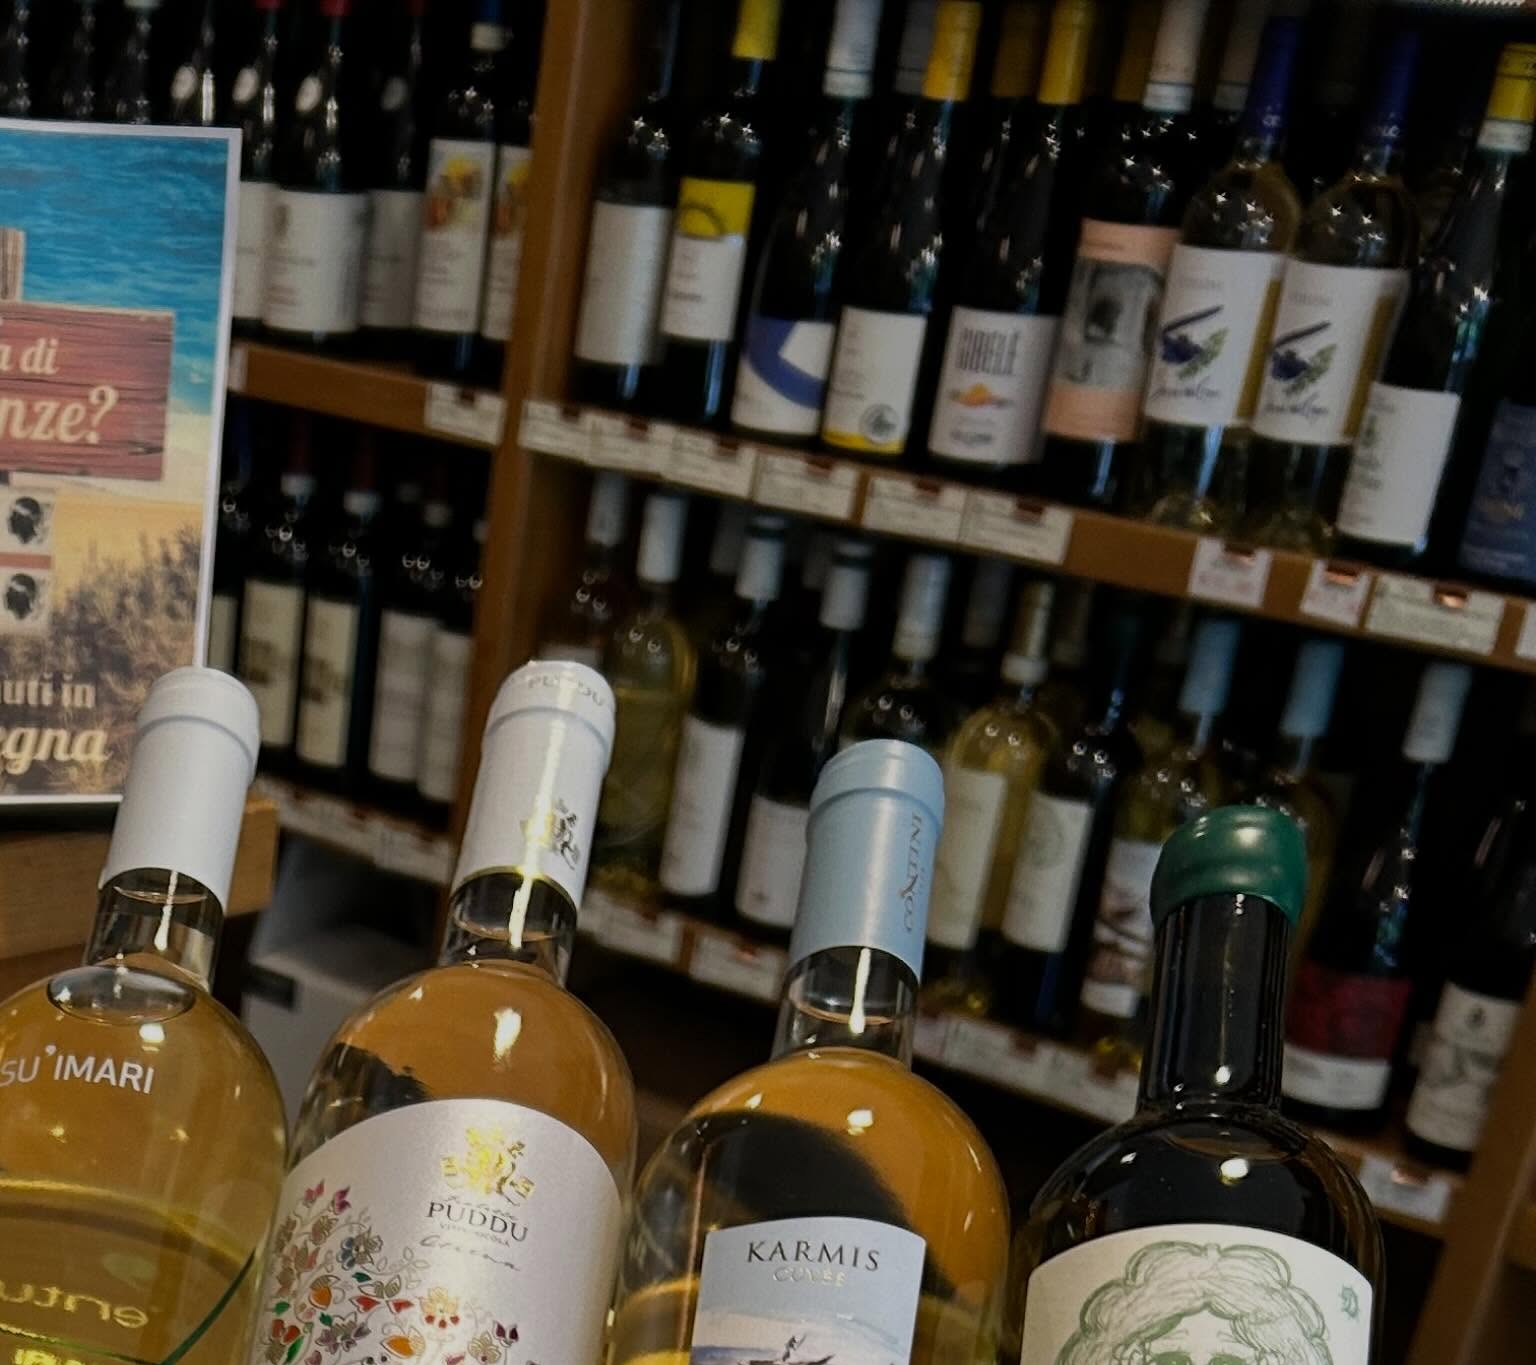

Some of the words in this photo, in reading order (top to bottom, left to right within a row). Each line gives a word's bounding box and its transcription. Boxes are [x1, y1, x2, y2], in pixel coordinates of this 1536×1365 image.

[19, 337, 61, 376] di
[61, 674, 97, 709] in
[425, 1201, 529, 1242] PUDDU
[747, 1240, 880, 1272] KARMIS
